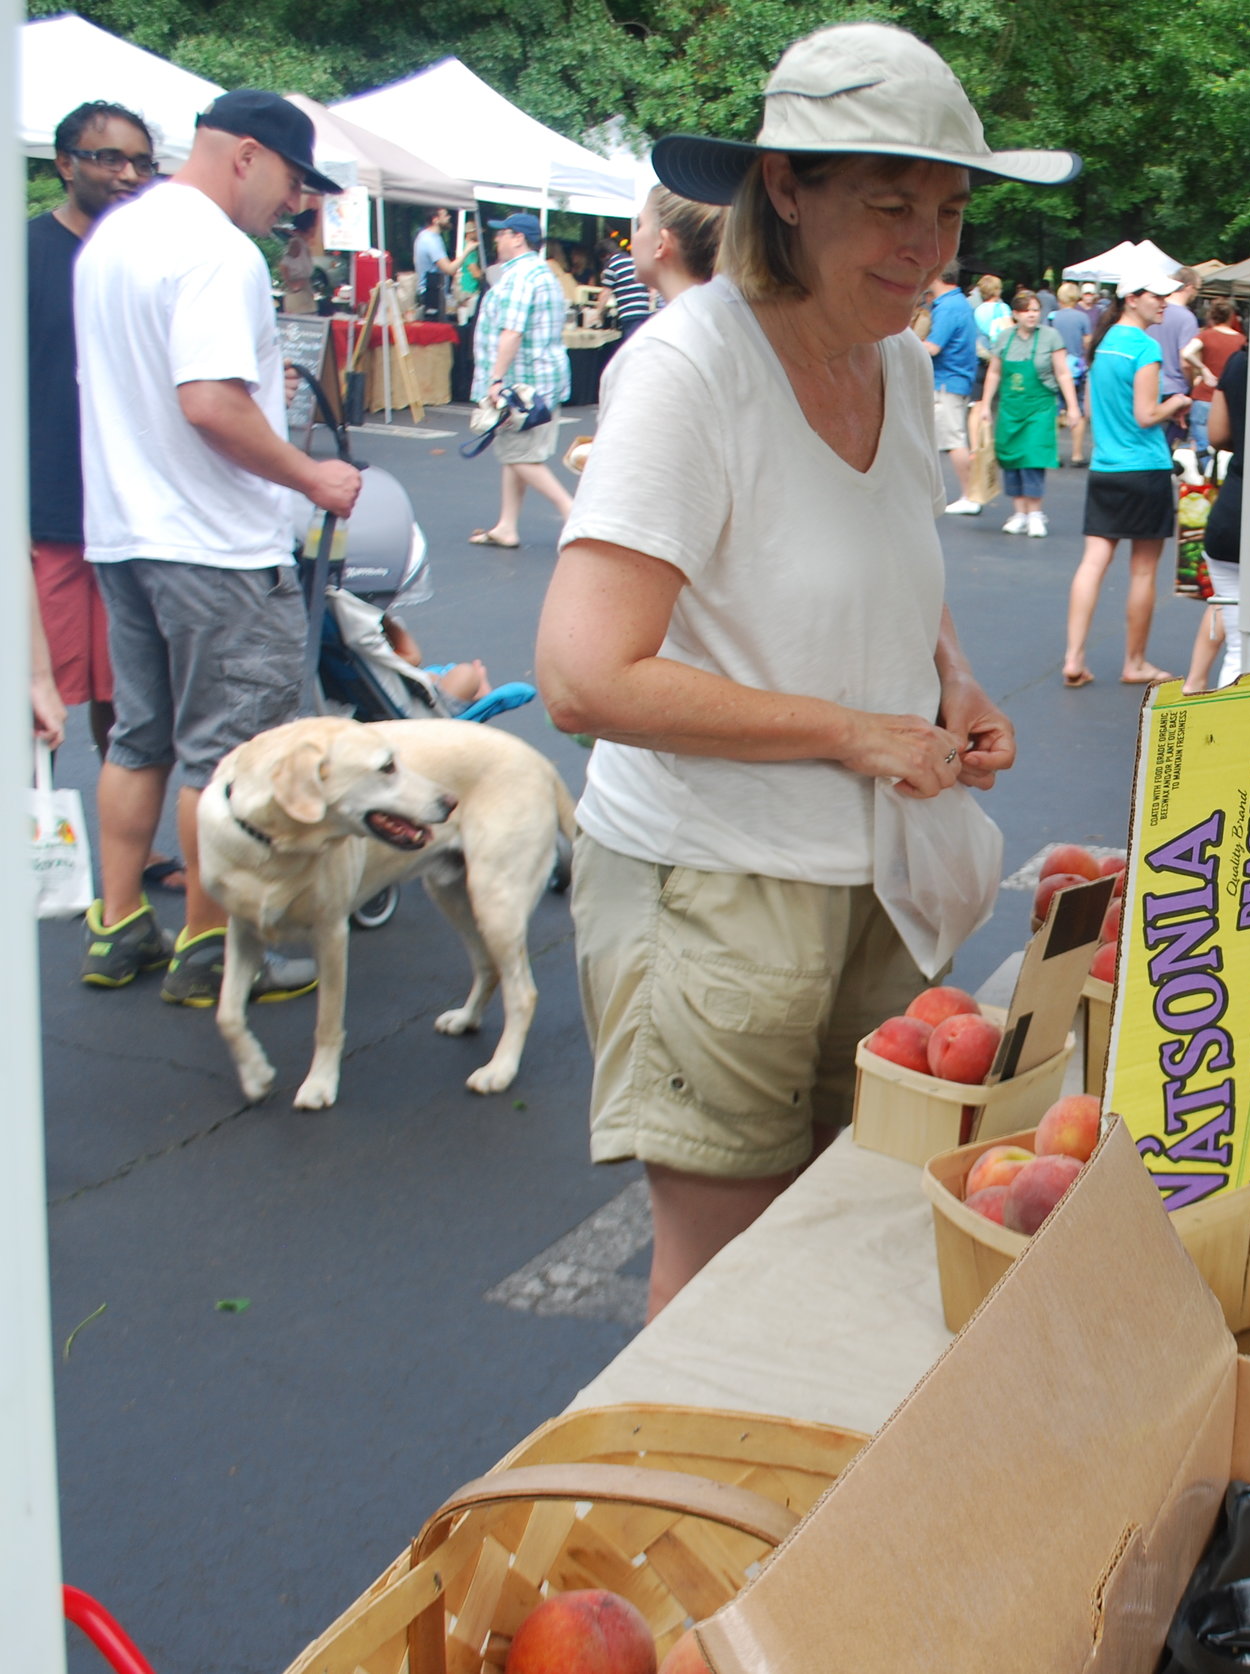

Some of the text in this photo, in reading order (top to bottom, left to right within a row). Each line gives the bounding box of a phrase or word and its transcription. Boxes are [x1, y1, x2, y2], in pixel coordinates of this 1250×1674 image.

[1150, 712, 1169, 827] COATED WITH FOOD GRADE ORGANIC
[1160, 711, 1178, 820] BEESWAX AND/OR PLANT OIL BASE
[1172, 710, 1187, 790] TO MAINTAIN FRESHNESS
[1226, 790, 1249, 898] Quality Brand
